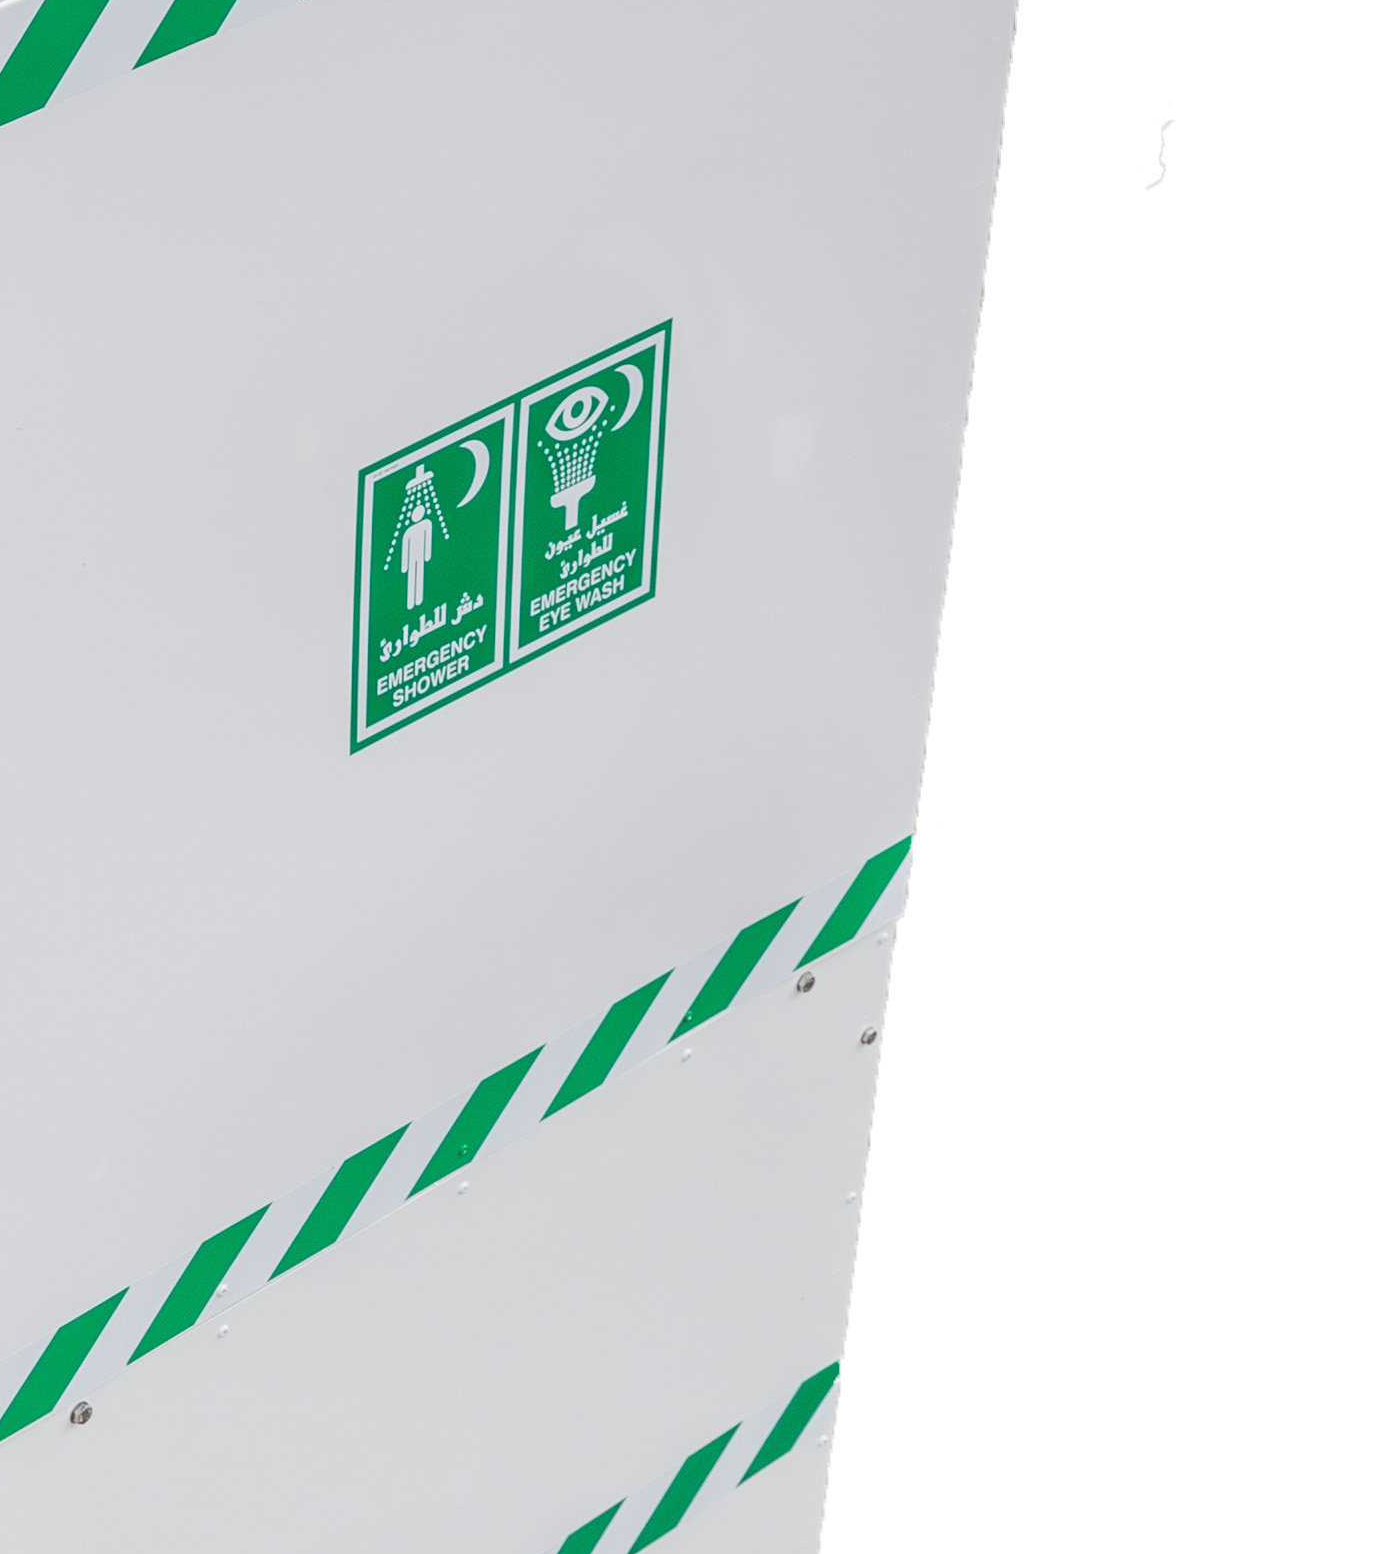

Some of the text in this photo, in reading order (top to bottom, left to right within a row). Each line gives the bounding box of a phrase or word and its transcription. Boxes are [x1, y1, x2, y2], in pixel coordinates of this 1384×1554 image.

[544, 500, 628, 560] غسيل عيون
[530, 548, 637, 617] EMERGENCY
[539, 574, 625, 632] EYE WASH
[377, 624, 487, 696] EMERGENCY
[392, 655, 470, 707] SHOWER
